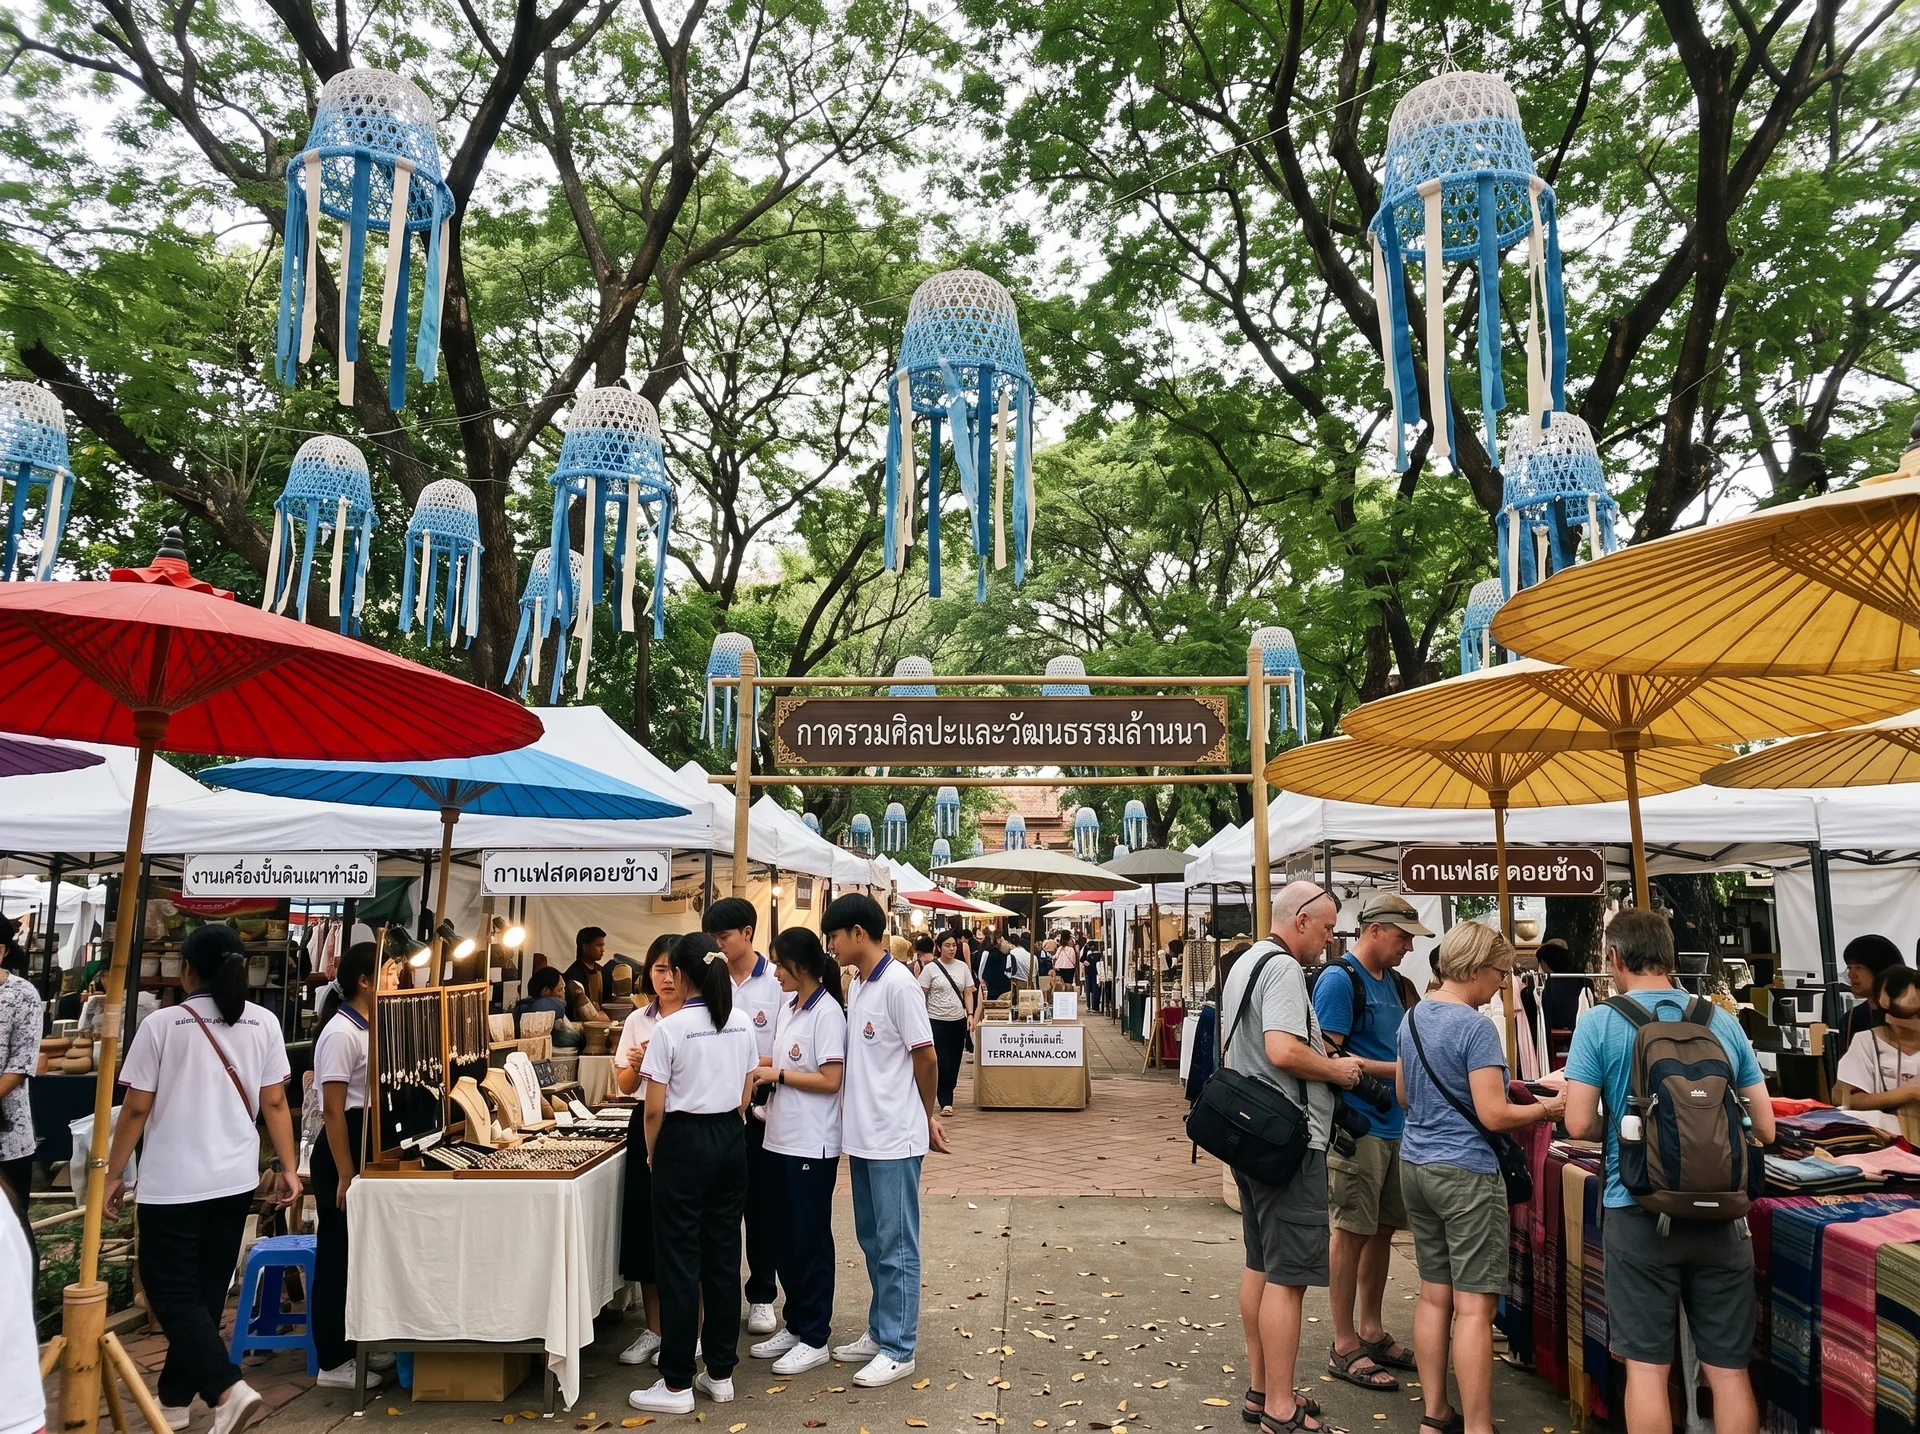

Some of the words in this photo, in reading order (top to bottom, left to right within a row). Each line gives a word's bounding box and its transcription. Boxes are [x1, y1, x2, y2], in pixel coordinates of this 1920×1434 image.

[796, 710, 1208, 746] กาดรวมศิลปะและวัฒนธรรมล้านนา
[192, 857, 368, 884] งานเครื่องปั้นดินเผาทำมือ
[493, 857, 658, 883] กาแฟสดดอยช้าง
[1410, 856, 1595, 882] กาแฟสดดอยช้าง
[987, 1050, 1077, 1059] TERRALANNA.COM
